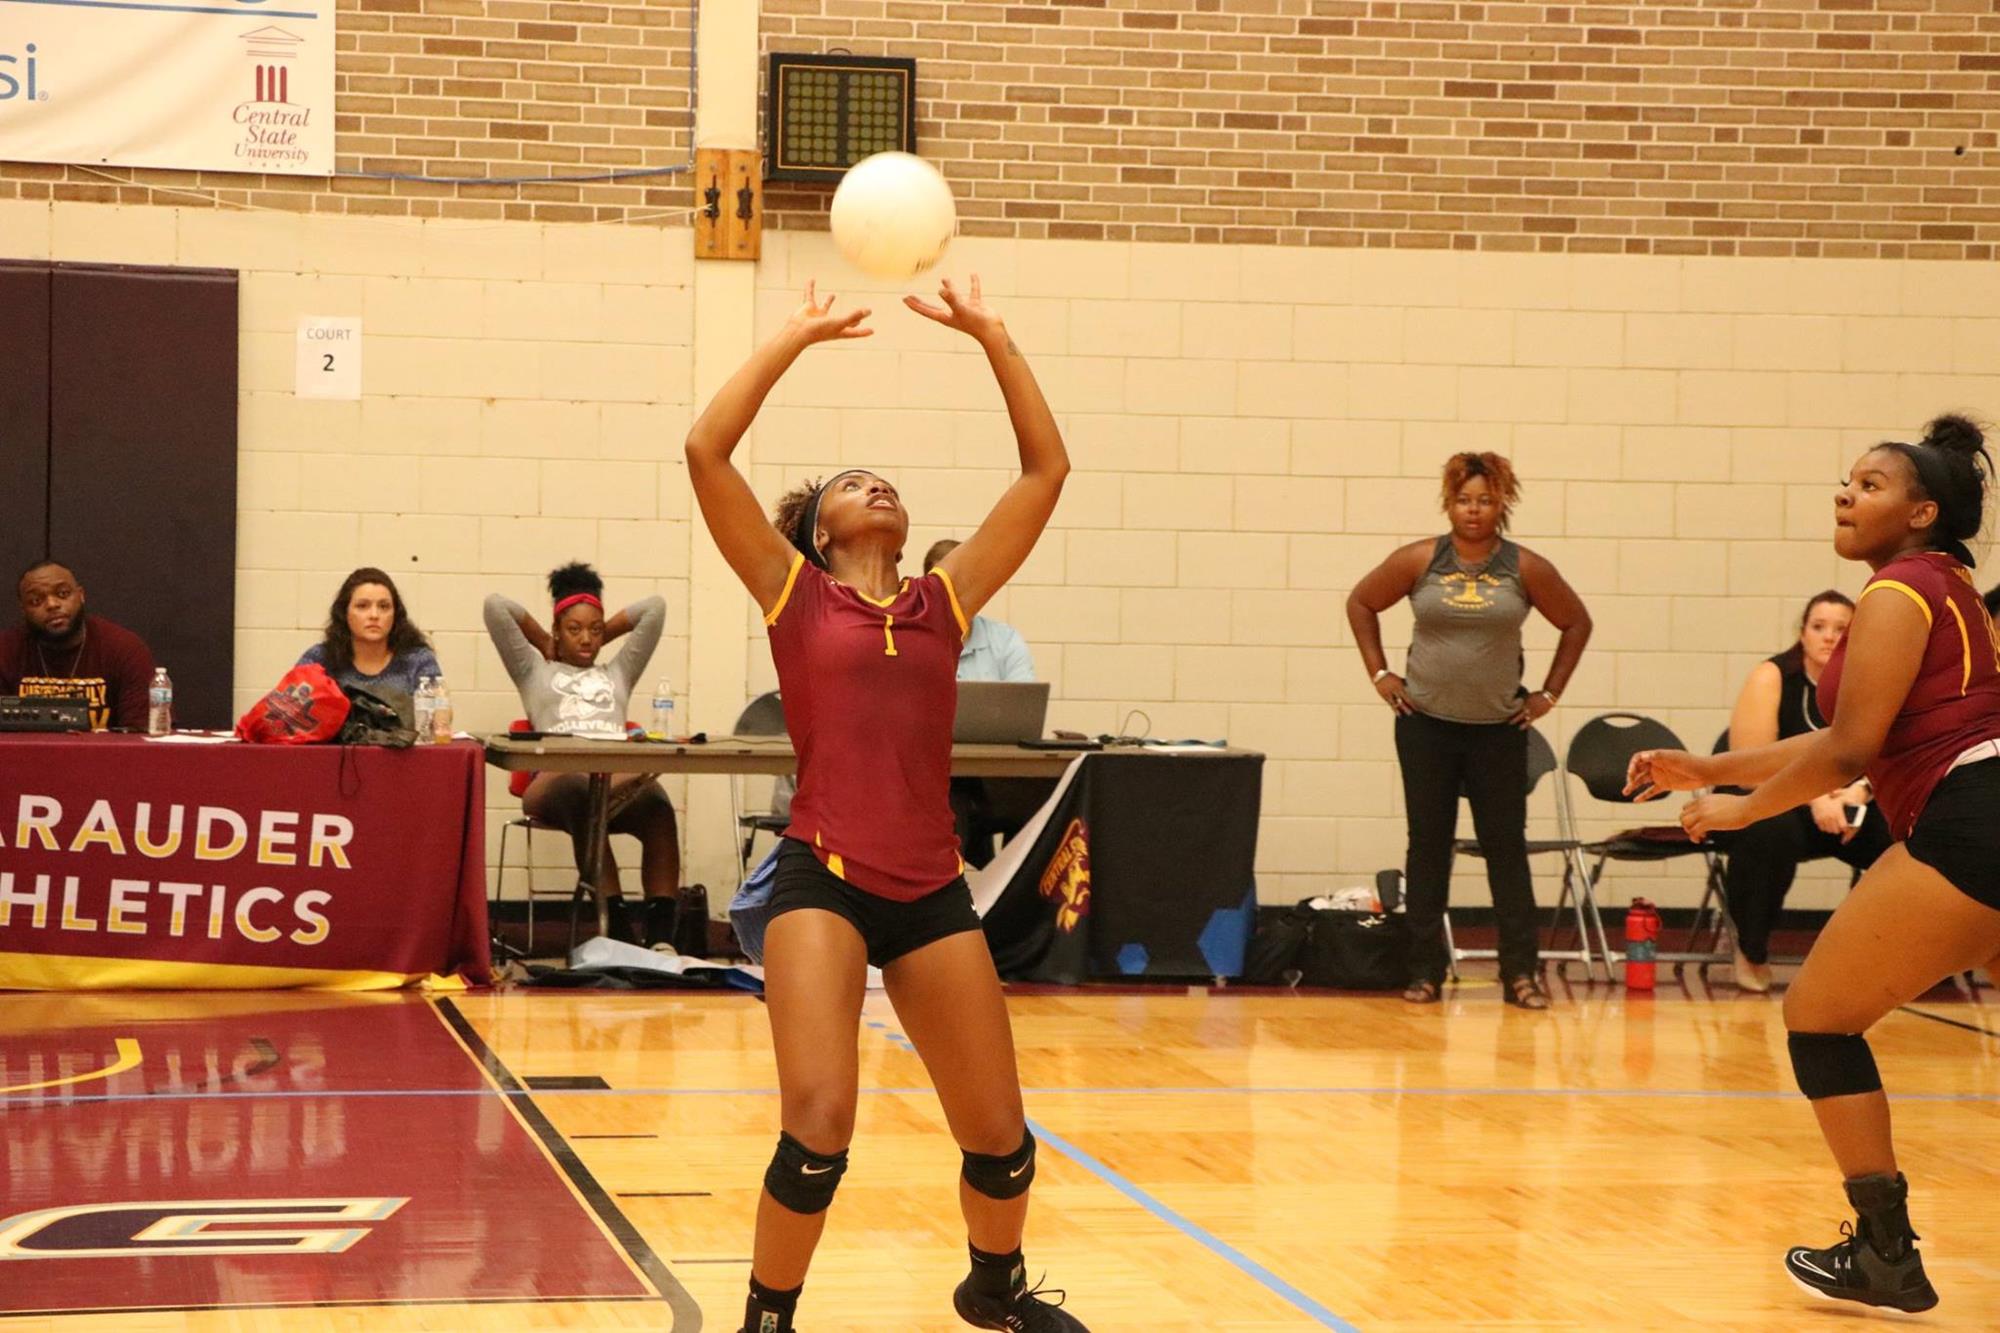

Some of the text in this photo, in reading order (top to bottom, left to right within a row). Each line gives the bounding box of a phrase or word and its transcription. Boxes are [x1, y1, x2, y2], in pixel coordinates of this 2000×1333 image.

[232, 103, 311, 127] Central
[245, 124, 297, 145] State
[234, 143, 309, 165] University
[306, 328, 352, 341] COURT
[322, 353, 335, 372] 2
[883, 613, 898, 657] 1
[0, 794, 355, 869] RAUDER
